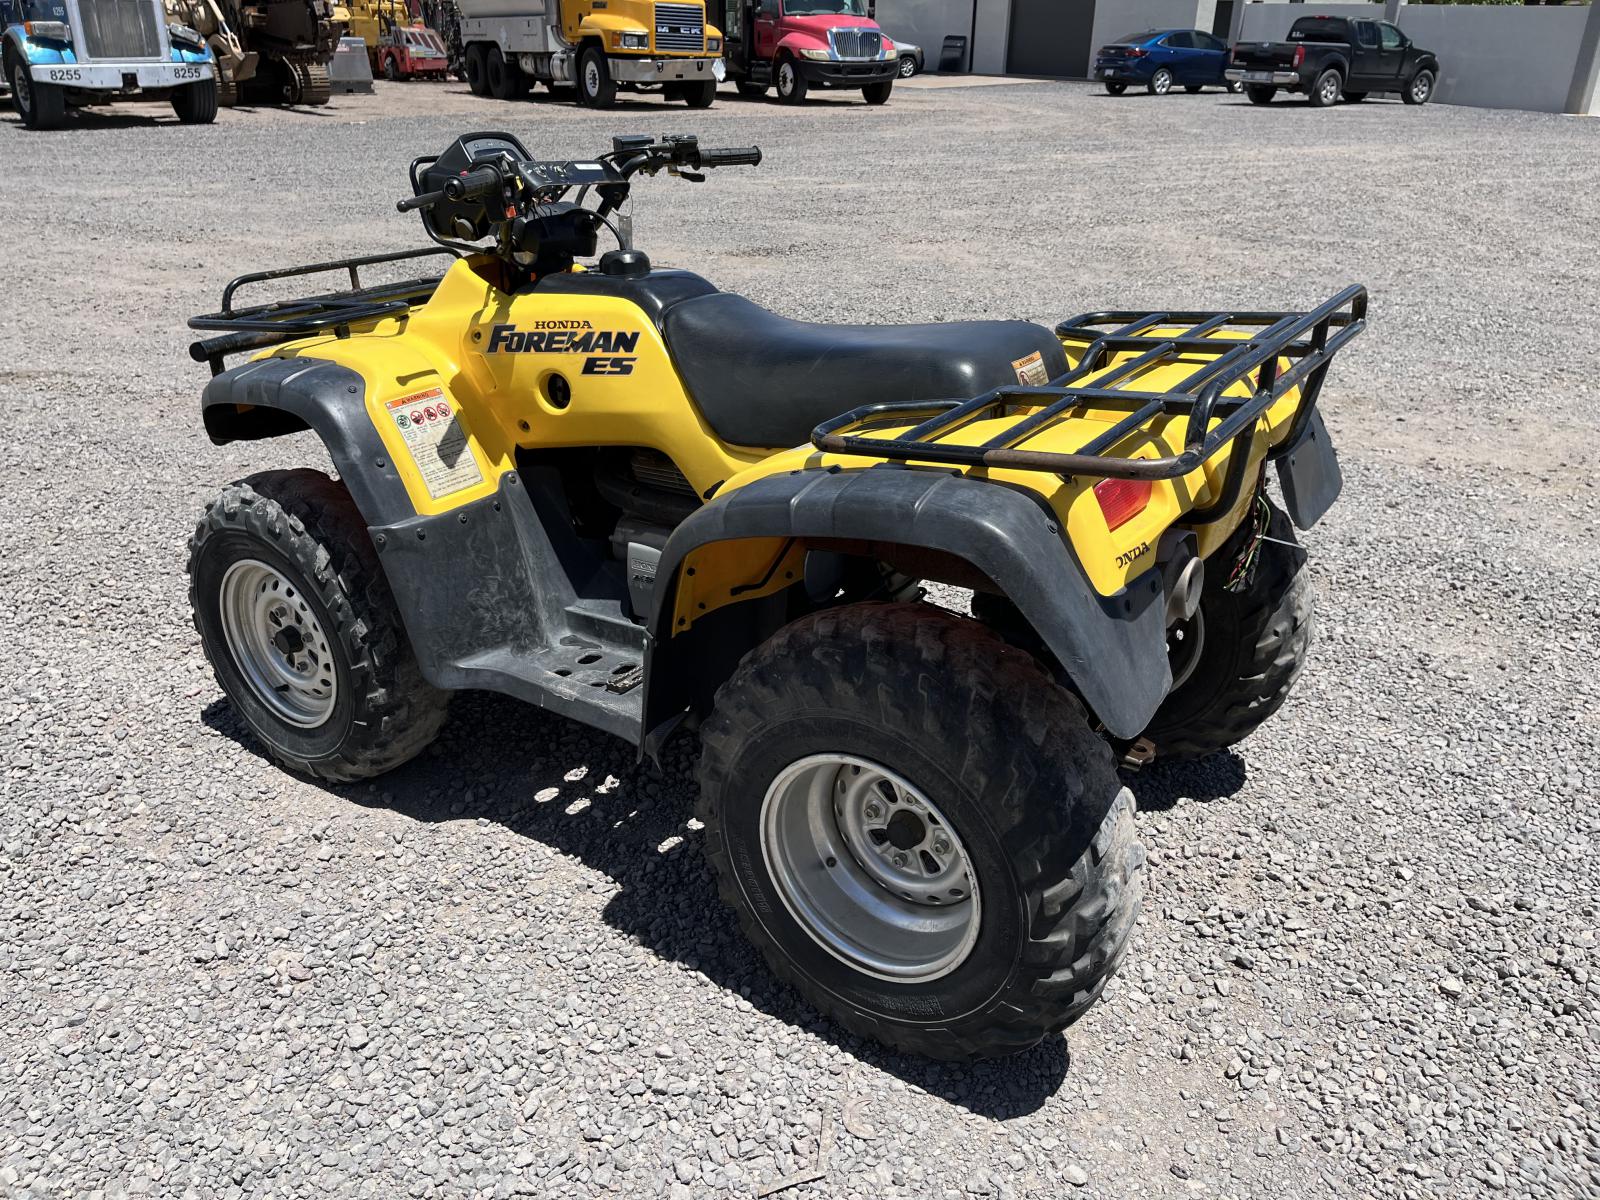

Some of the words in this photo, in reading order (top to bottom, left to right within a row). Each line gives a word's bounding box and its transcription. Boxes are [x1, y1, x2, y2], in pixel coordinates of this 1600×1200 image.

[657, 26, 701, 34] MCK
[50, 69, 81, 81] 8255
[174, 68, 201, 79] 8255
[535, 320, 593, 329] HONDA
[487, 324, 640, 353] FOREMAN
[581, 357, 638, 375] ES
